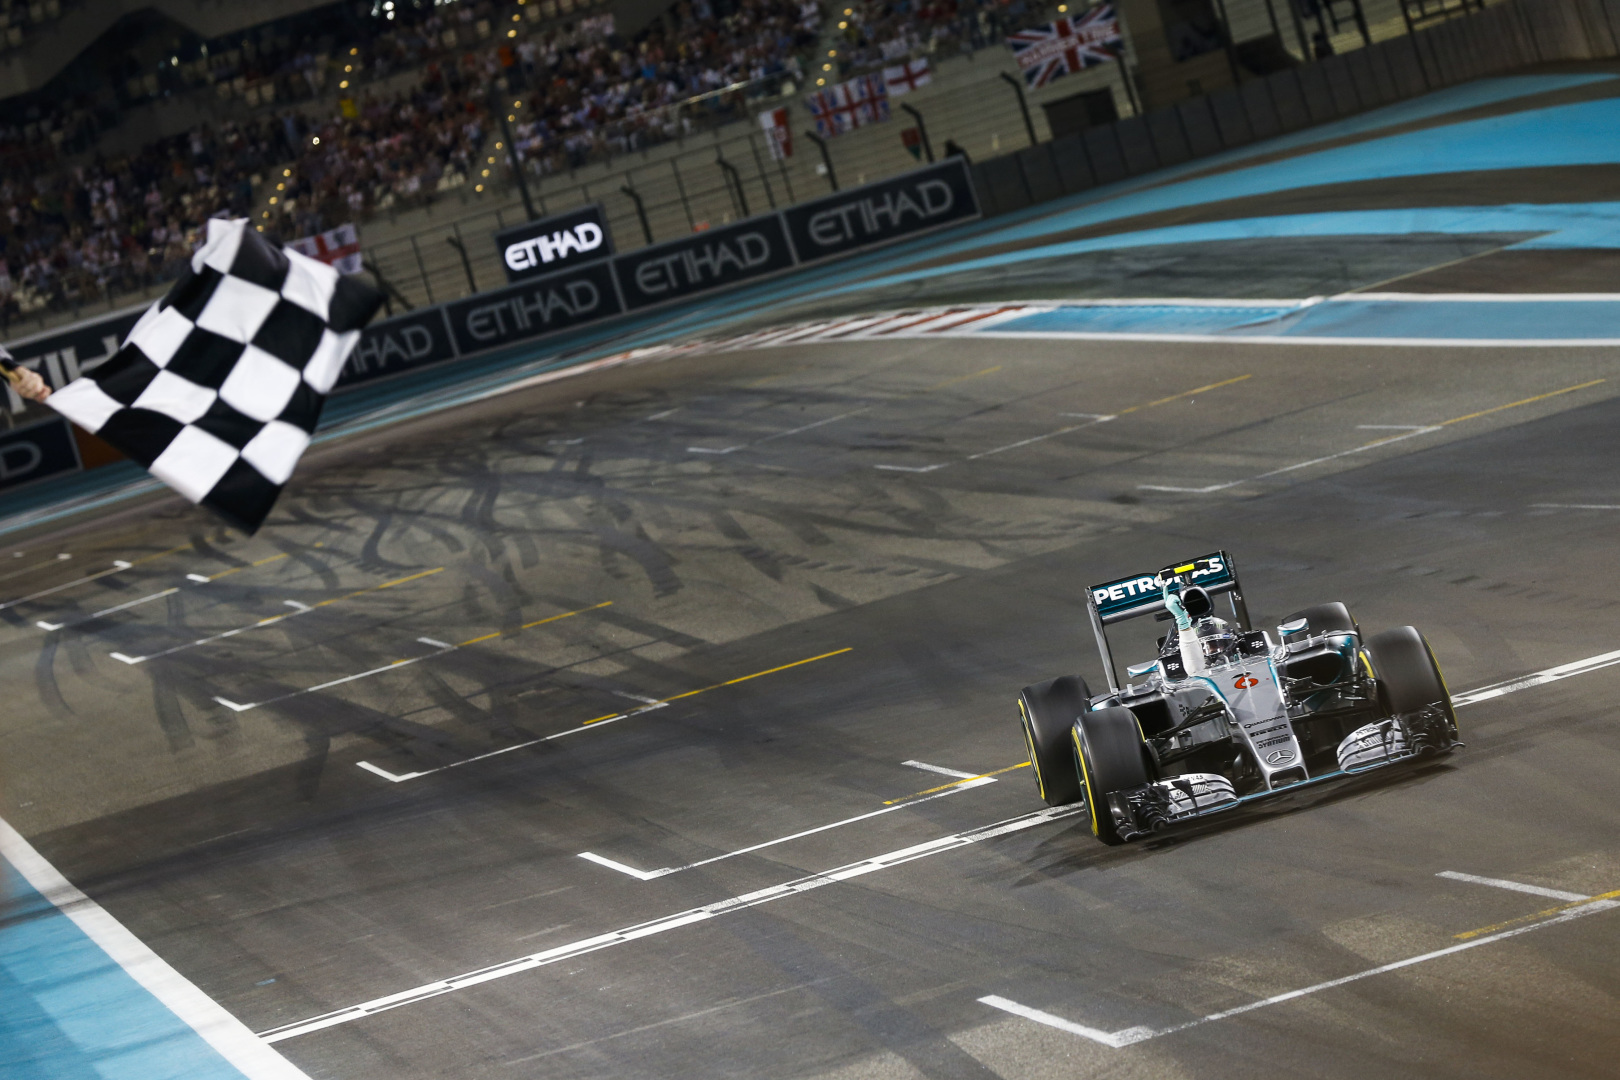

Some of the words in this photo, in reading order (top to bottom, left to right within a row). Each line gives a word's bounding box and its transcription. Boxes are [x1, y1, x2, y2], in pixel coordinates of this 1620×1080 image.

[807, 178, 953, 245] ETIHAD
[504, 222, 603, 271] ETIHAD
[635, 231, 770, 293] ETIHAD
[466, 279, 599, 340] ETIHAD
[349, 325, 434, 376] IHAD
